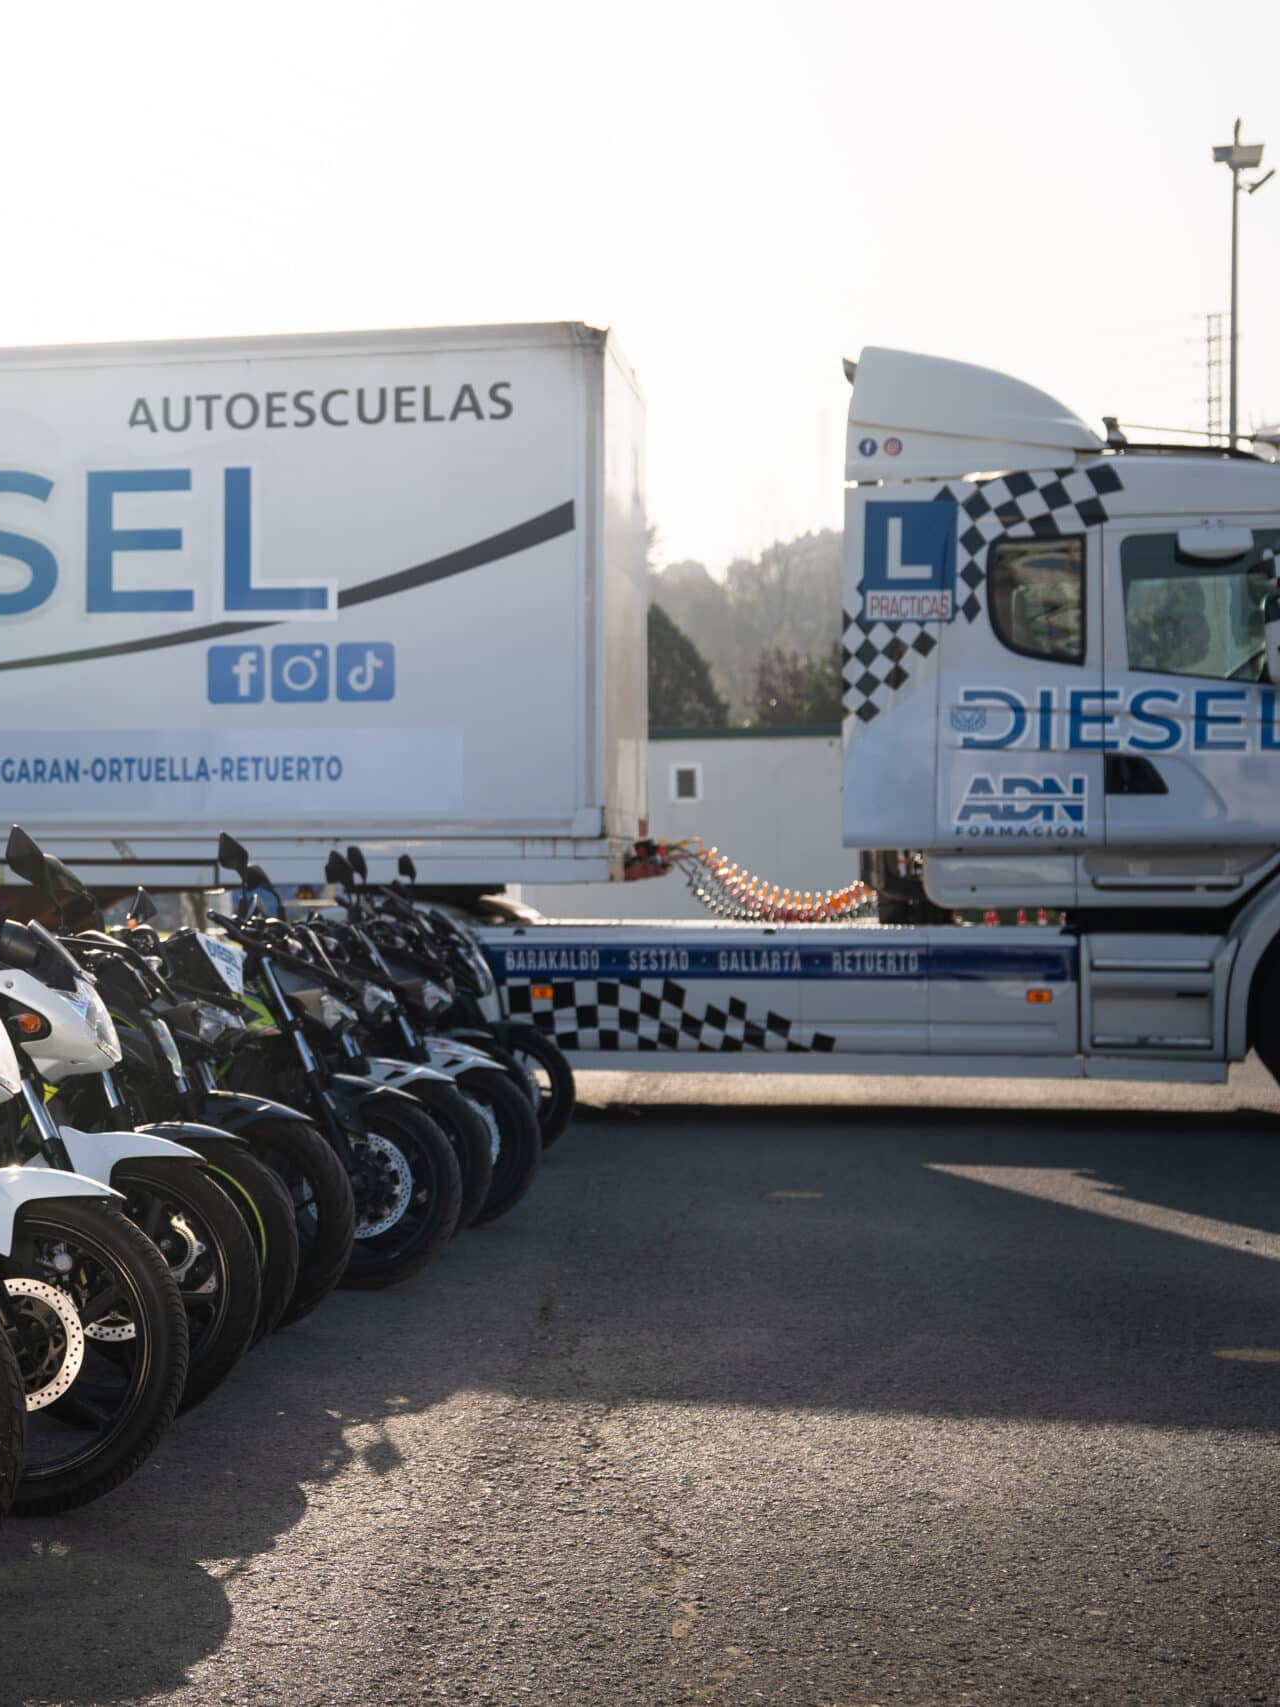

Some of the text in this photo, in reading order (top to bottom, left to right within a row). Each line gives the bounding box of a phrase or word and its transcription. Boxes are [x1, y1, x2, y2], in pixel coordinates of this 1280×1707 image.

[128, 381, 514, 433] AUTOESCUELAS
[887, 517, 933, 579] L
[869, 594, 950, 618] PRACTICAS
[956, 776, 1085, 822] ADN
[505, 950, 920, 974] BARAKALDO SESTAO GALLARTA RETUERTO
